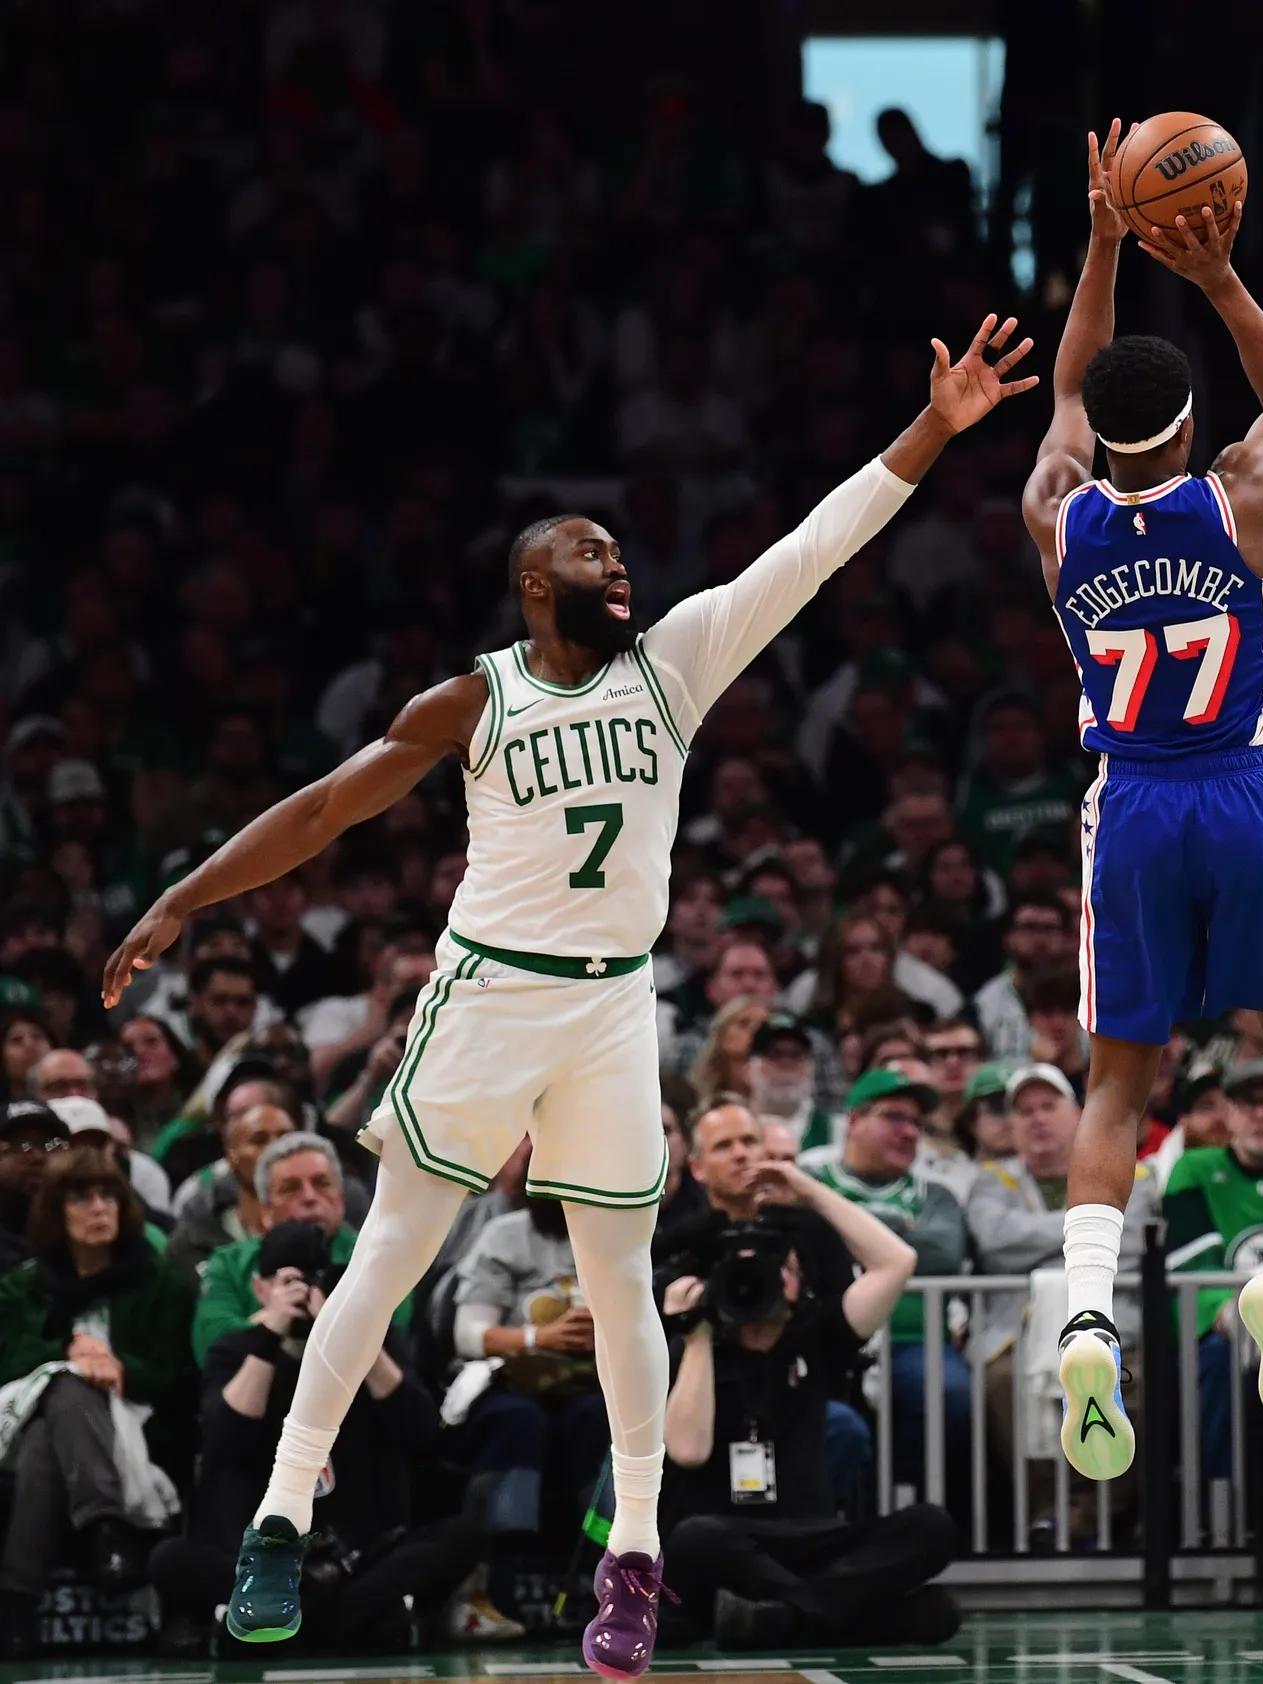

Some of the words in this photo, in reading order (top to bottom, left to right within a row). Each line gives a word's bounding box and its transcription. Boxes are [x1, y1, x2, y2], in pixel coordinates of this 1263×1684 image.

[1155, 138, 1235, 180] Wilson
[1065, 558, 1245, 629] EDGECOMBE
[603, 684, 644, 700] Amica
[1086, 613, 1241, 732] 77
[503, 718, 659, 806] CELTICS
[564, 803, 624, 888] 7
